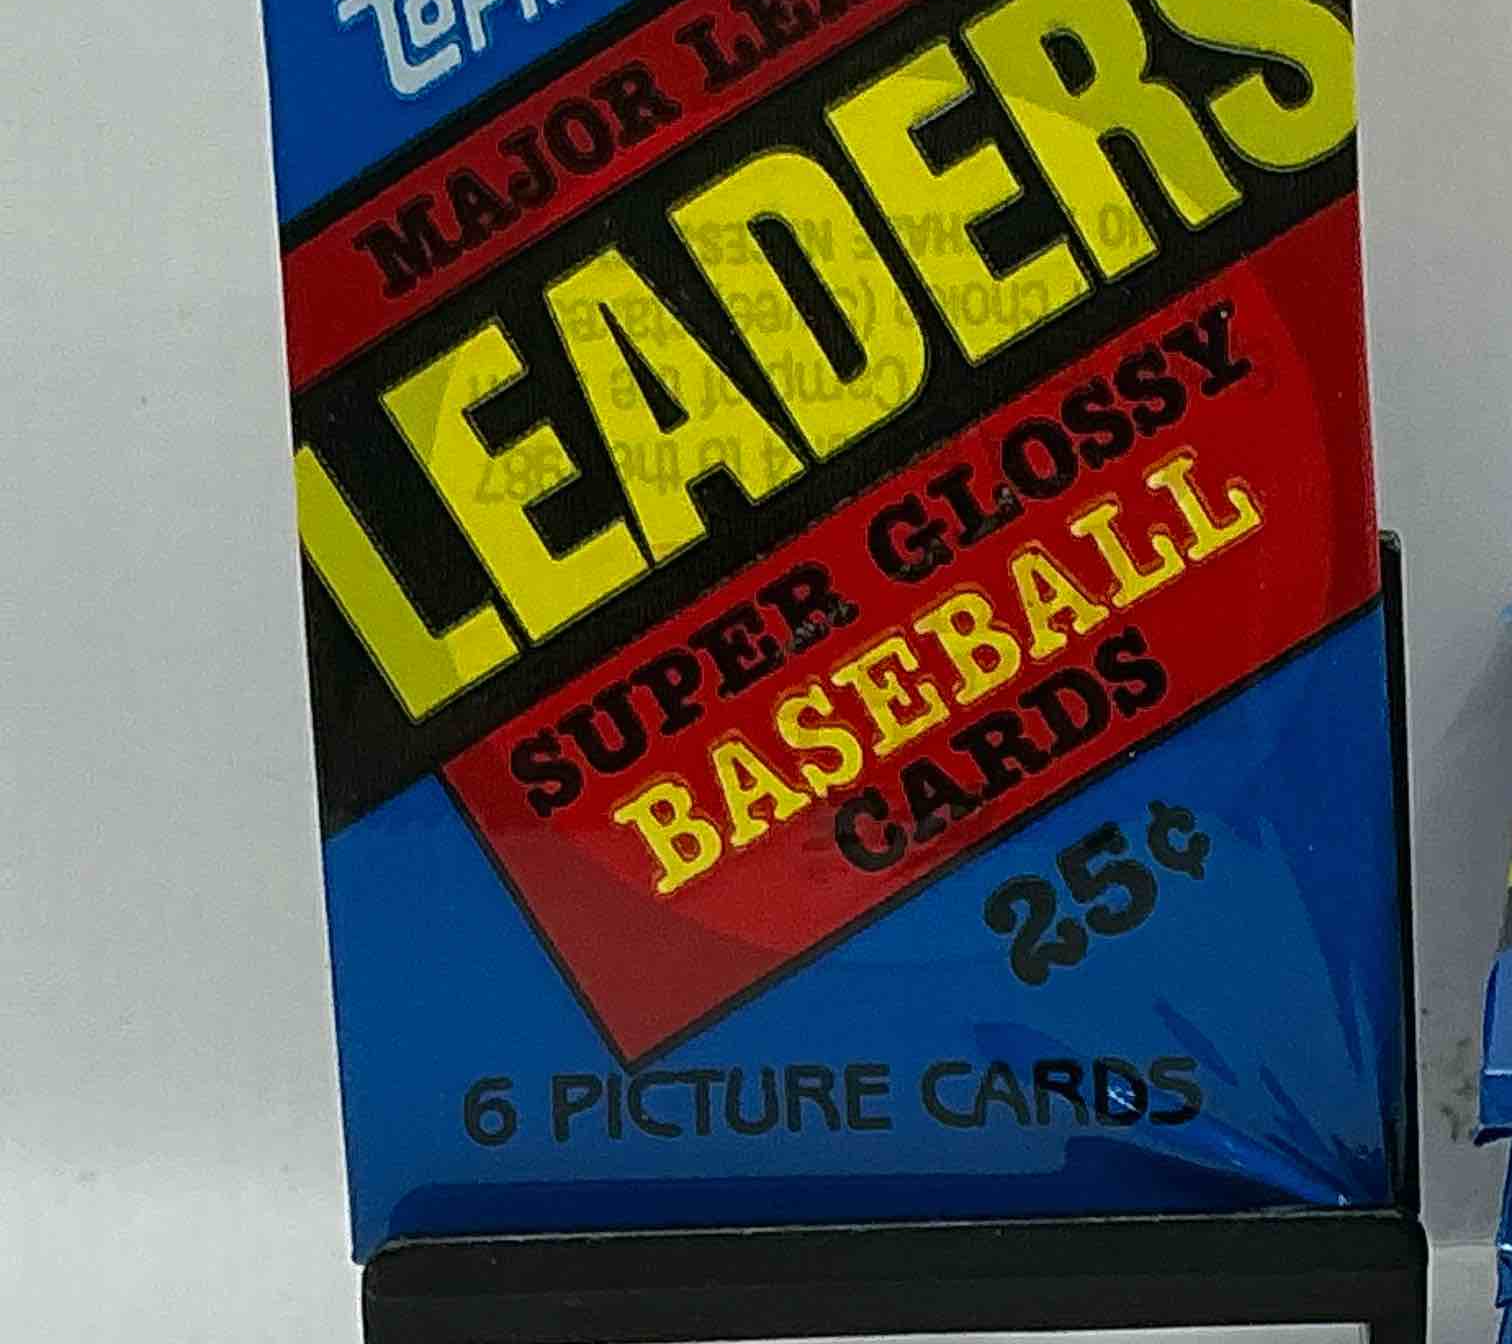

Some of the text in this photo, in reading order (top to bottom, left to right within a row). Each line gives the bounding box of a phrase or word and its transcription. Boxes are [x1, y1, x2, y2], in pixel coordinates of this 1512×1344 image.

[352, 64, 683, 299] MAJOR
[508, 302, 1253, 817] SUPER GLOSSY
[614, 449, 1262, 895] BASEBALL
[833, 629, 1168, 876] CARDS
[983, 798, 1212, 986] 25¢
[462, 1056, 1202, 1146] 6 PICTURE CARDS
